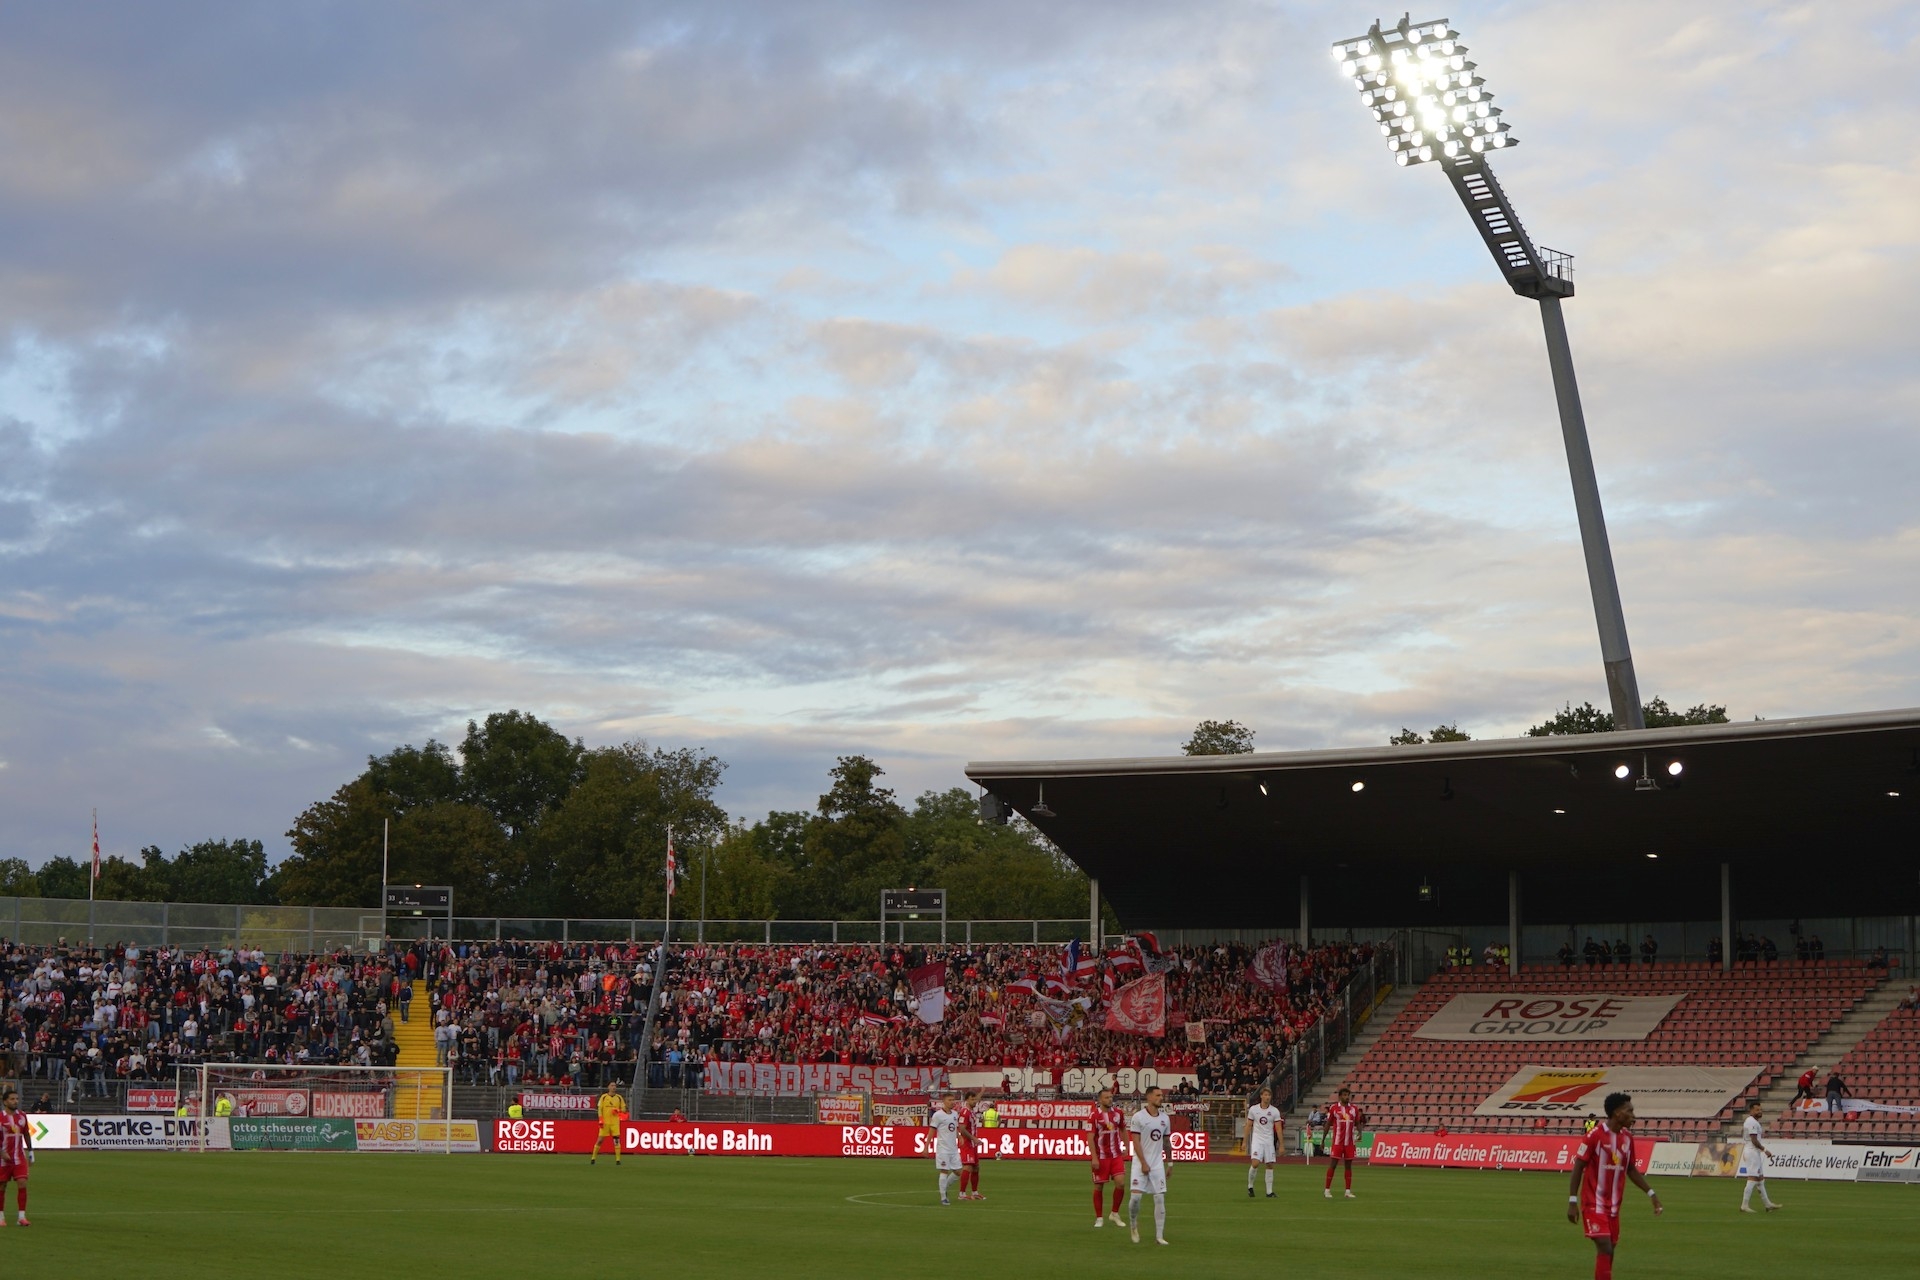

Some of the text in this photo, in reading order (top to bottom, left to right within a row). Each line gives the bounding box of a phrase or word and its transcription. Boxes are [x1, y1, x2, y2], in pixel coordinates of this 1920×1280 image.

[1483, 999, 1632, 1019] ROSE
[1469, 1021, 1608, 1035] GROUP
[708, 1062, 944, 1098] NORDHESSEN
[1114, 1067, 1158, 1094] 30
[257, 1102, 278, 1113] TOUR
[312, 1093, 385, 1117] GUDENSBERG
[523, 1095, 591, 1108] CHAOSBOYS
[820, 1099, 860, 1110] VORSTADT
[1499, 1102, 1587, 1111] BECK
[997, 1104, 1092, 1117] ULTRAS KASSEL
[79, 1119, 210, 1137] Starke-DMS
[233, 1123, 317, 1133] otto scheuerer
[371, 1122, 416, 1141] ASB
[499, 1121, 554, 1139] ROSE
[81, 1138, 210, 1147] Dokumenten-Managemet
[234, 1133, 319, 1143] bautenschutz gmbh
[626, 1128, 772, 1150] Deutsche Bahn
[842, 1127, 893, 1144] ROSE
[1169, 1133, 1205, 1149] OSE
[499, 1140, 554, 1151] GLEISBAU
[842, 1145, 893, 1155] GLEISBAU
[1000, 1134, 1015, 1154] &
[1162, 1150, 1205, 1160] EISBAU
[1375, 1142, 1398, 1158] Das
[1401, 1143, 1430, 1159] Team
[1433, 1143, 1451, 1160] für
[1453, 1144, 1486, 1161] deine
[1489, 1145, 1548, 1164] Finanzen.
[1863, 1151, 1894, 1167] Fehr
[1652, 1161, 1680, 1171] Tierpark
[1769, 1155, 1858, 1169] Städtische Werke
